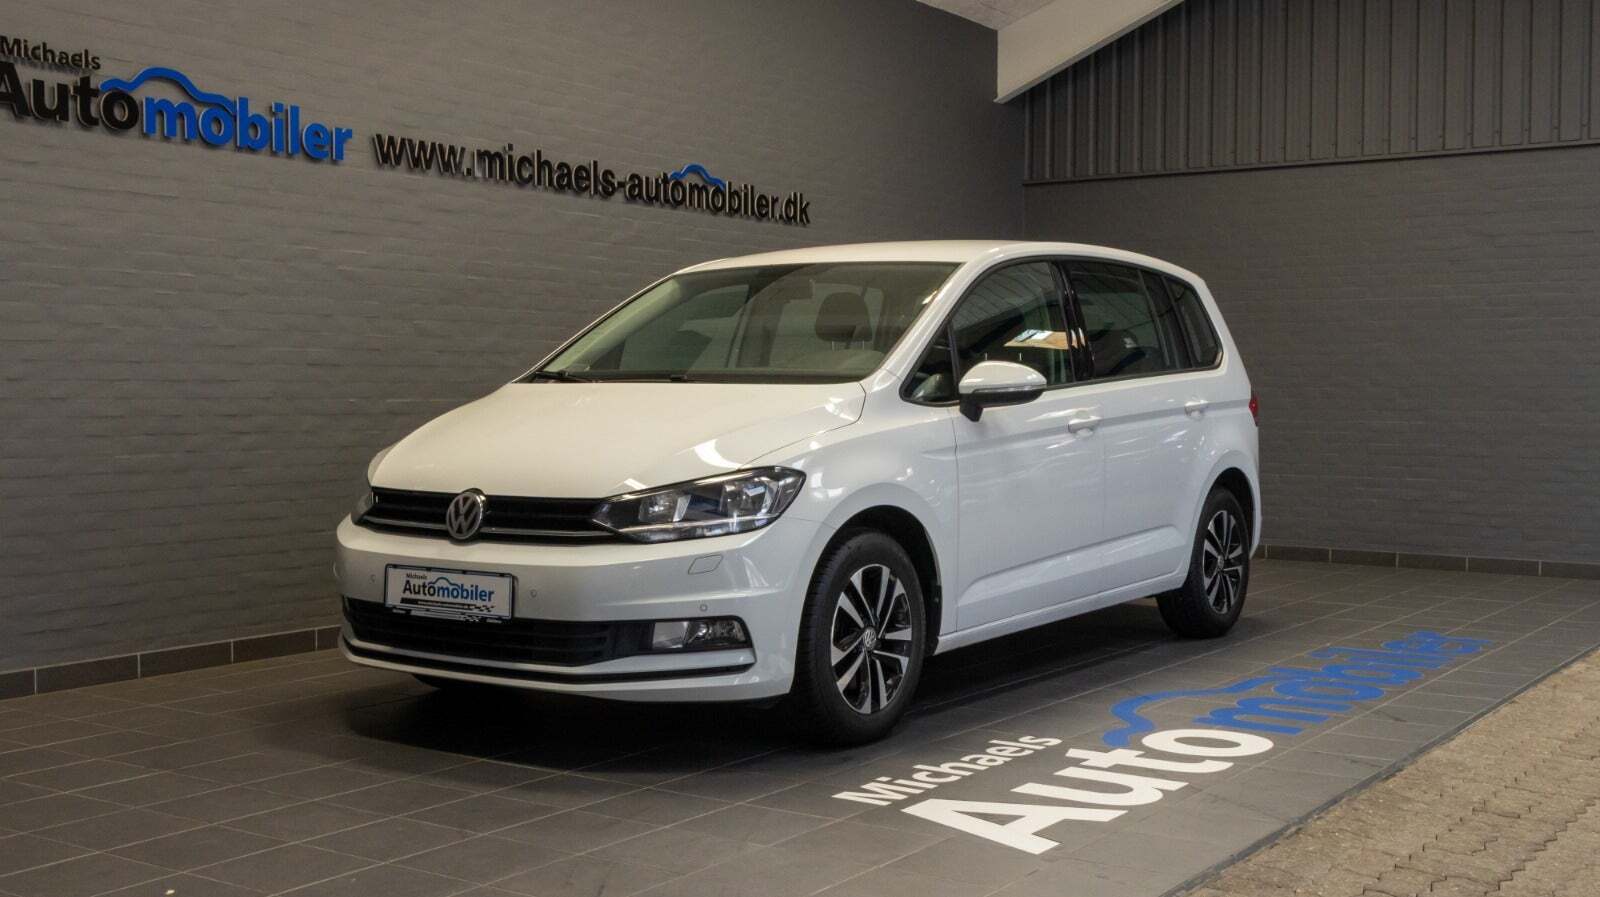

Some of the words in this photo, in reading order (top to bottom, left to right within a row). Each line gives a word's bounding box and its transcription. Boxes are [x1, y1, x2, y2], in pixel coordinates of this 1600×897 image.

[0, 36, 101, 70] Michaels
[373, 133, 811, 225] www.michaels-automobiler.dk
[403, 580, 495, 602] Automobiler
[831, 734, 1063, 807] Michaels
[902, 630, 1490, 856] Automobiler
